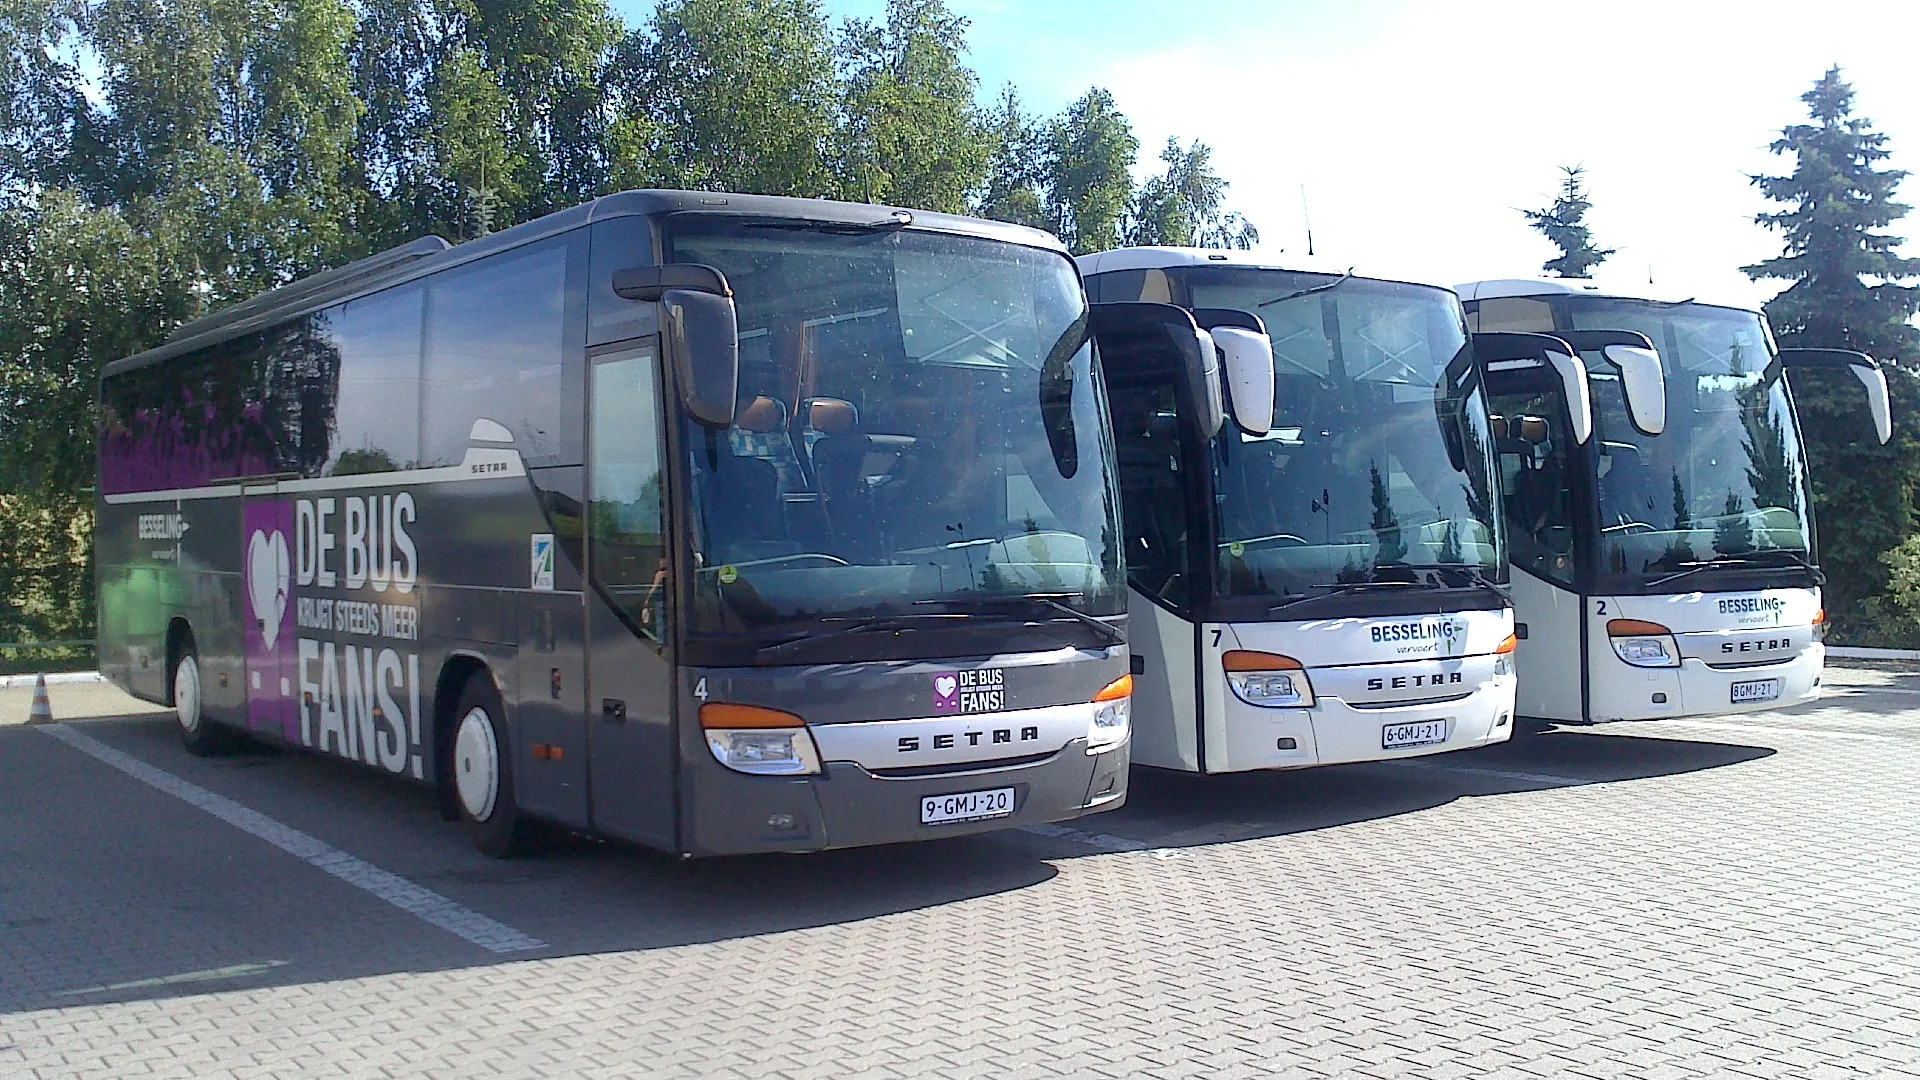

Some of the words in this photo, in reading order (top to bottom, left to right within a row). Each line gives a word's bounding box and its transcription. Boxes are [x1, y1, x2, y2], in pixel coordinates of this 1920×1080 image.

[472, 462, 507, 474] SETRA
[296, 497, 336, 588] DE
[345, 491, 418, 594] BUS
[1597, 601, 1606, 616] 2
[1718, 597, 1779, 614] BESSELING
[335, 599, 380, 636] STEEDS
[382, 603, 418, 640] MEER
[1210, 629, 1222, 648] 7
[1371, 621, 1453, 643] BESSELING
[1721, 638, 1790, 653] SETRA
[959, 670, 977, 687] DE
[979, 668, 1003, 685] BUS
[1367, 672, 1462, 691] SETRA
[693, 677, 708, 699] 4
[298, 638, 424, 780] FANS!
[960, 691, 1005, 712] FANS!
[898, 726, 1039, 753] SETRA
[1387, 723, 1438, 742] 6-GMJ-21
[926, 792, 1007, 818] 9-GMJ-20
